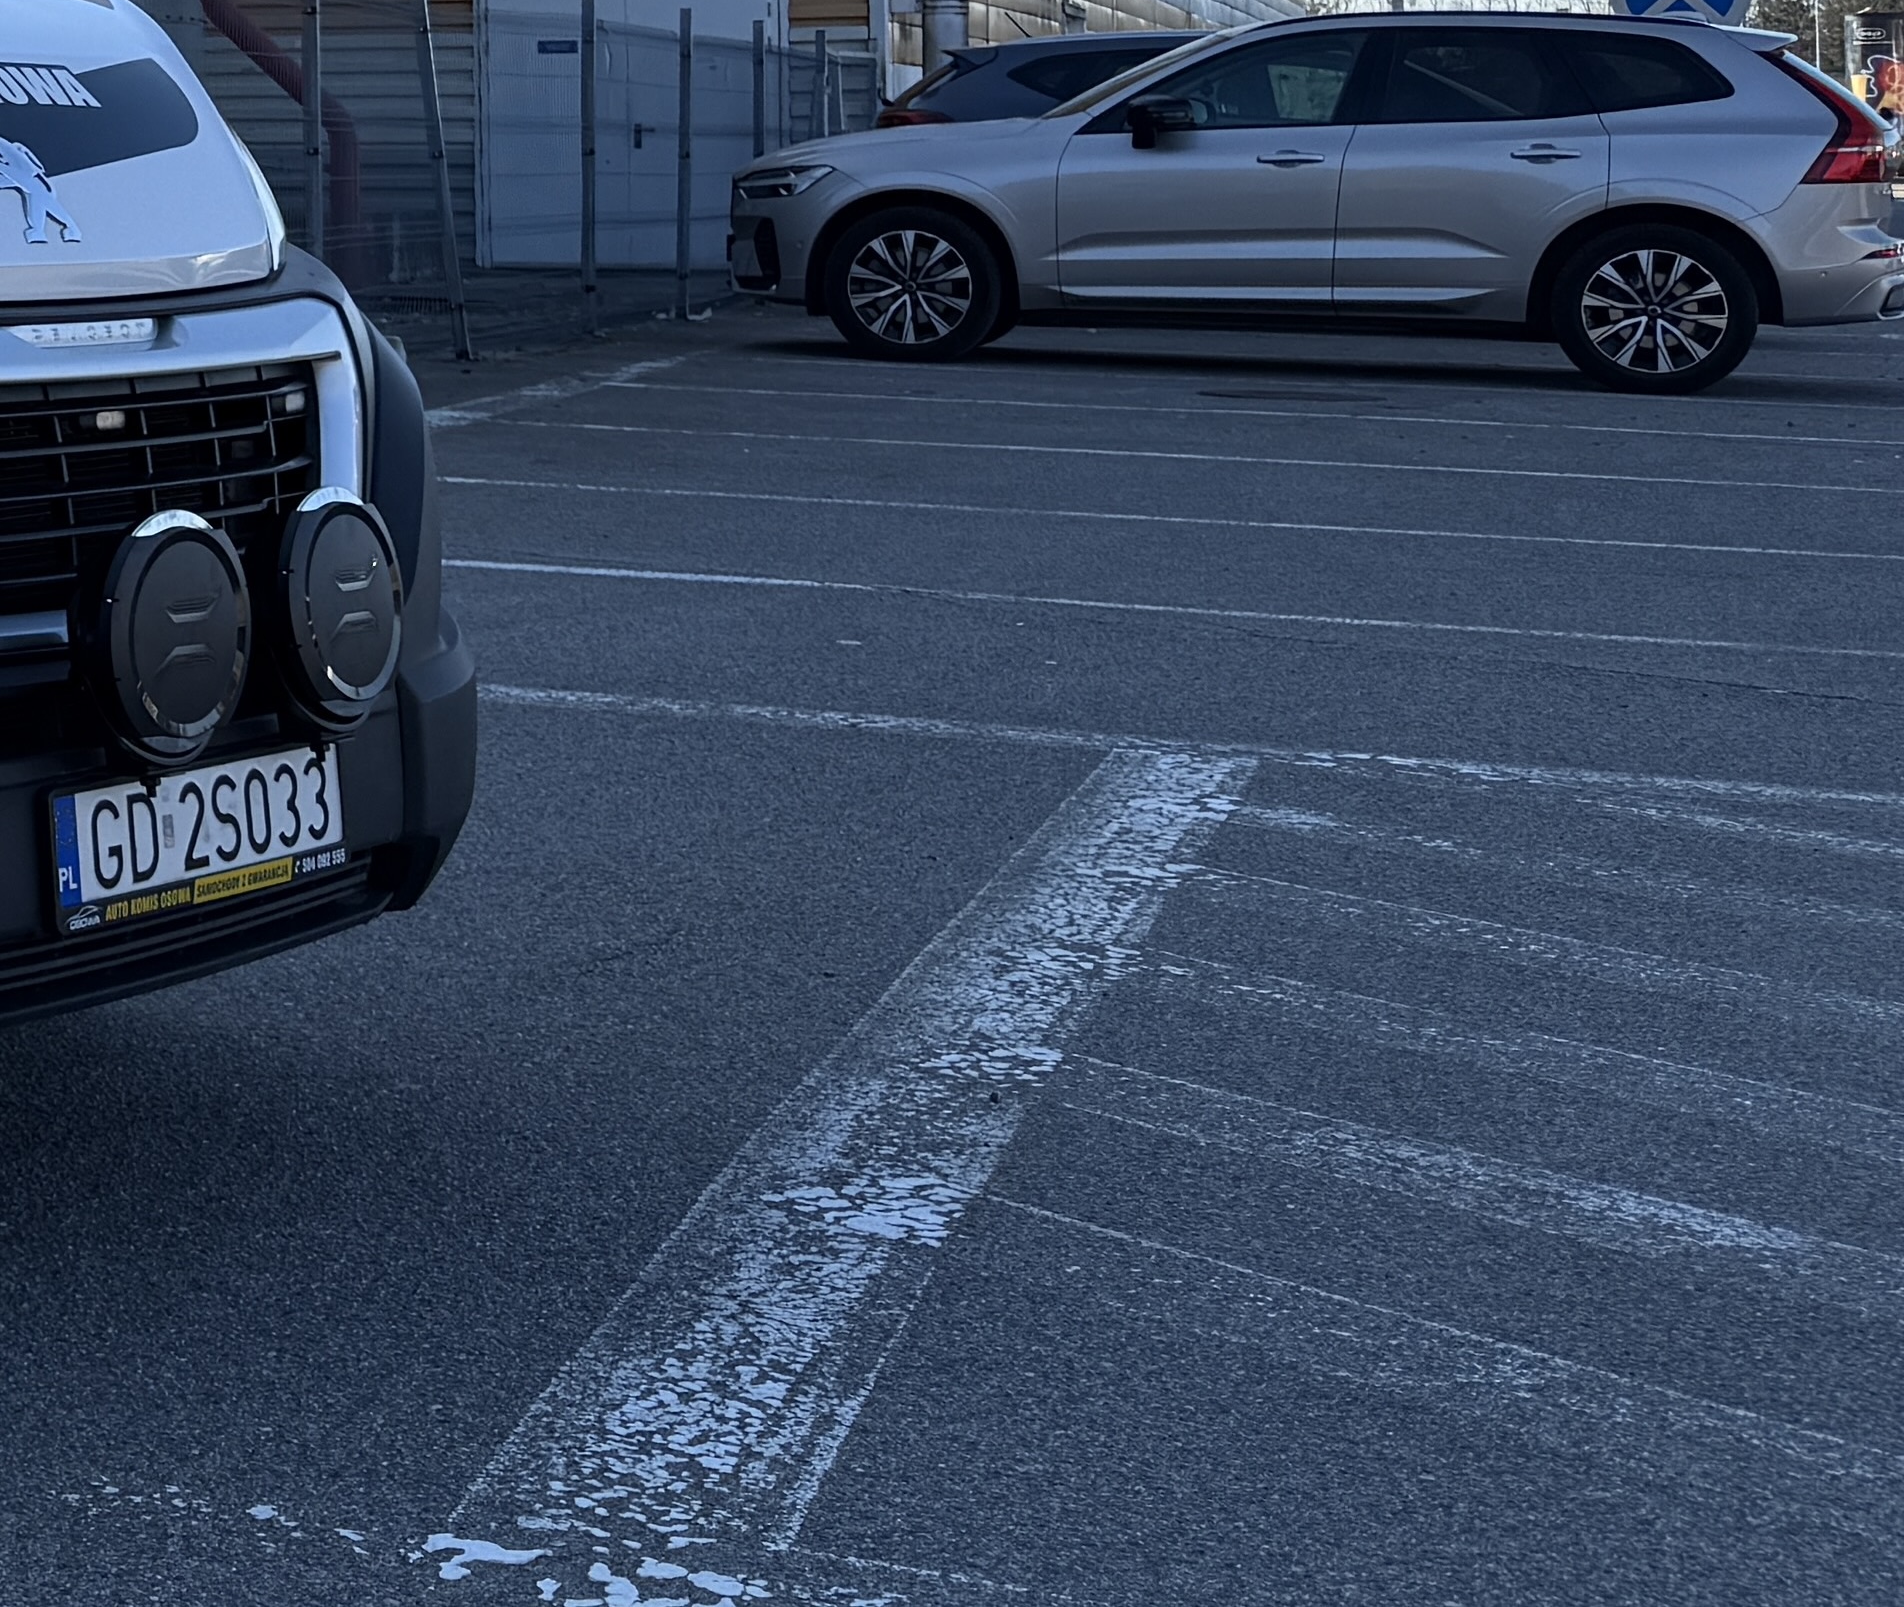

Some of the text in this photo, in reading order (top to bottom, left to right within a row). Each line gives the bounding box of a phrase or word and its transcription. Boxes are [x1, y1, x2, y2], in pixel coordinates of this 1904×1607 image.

[91, 757, 330, 889] GD 2S033
[302, 856, 316, 873] 504
[332, 847, 346, 865] 555
[58, 866, 78, 893] PL
[197, 878, 240, 898] SAMOCHODY
[242, 875, 247, 887] Z
[105, 886, 191, 921] AUTO KOMIS OSOWA
